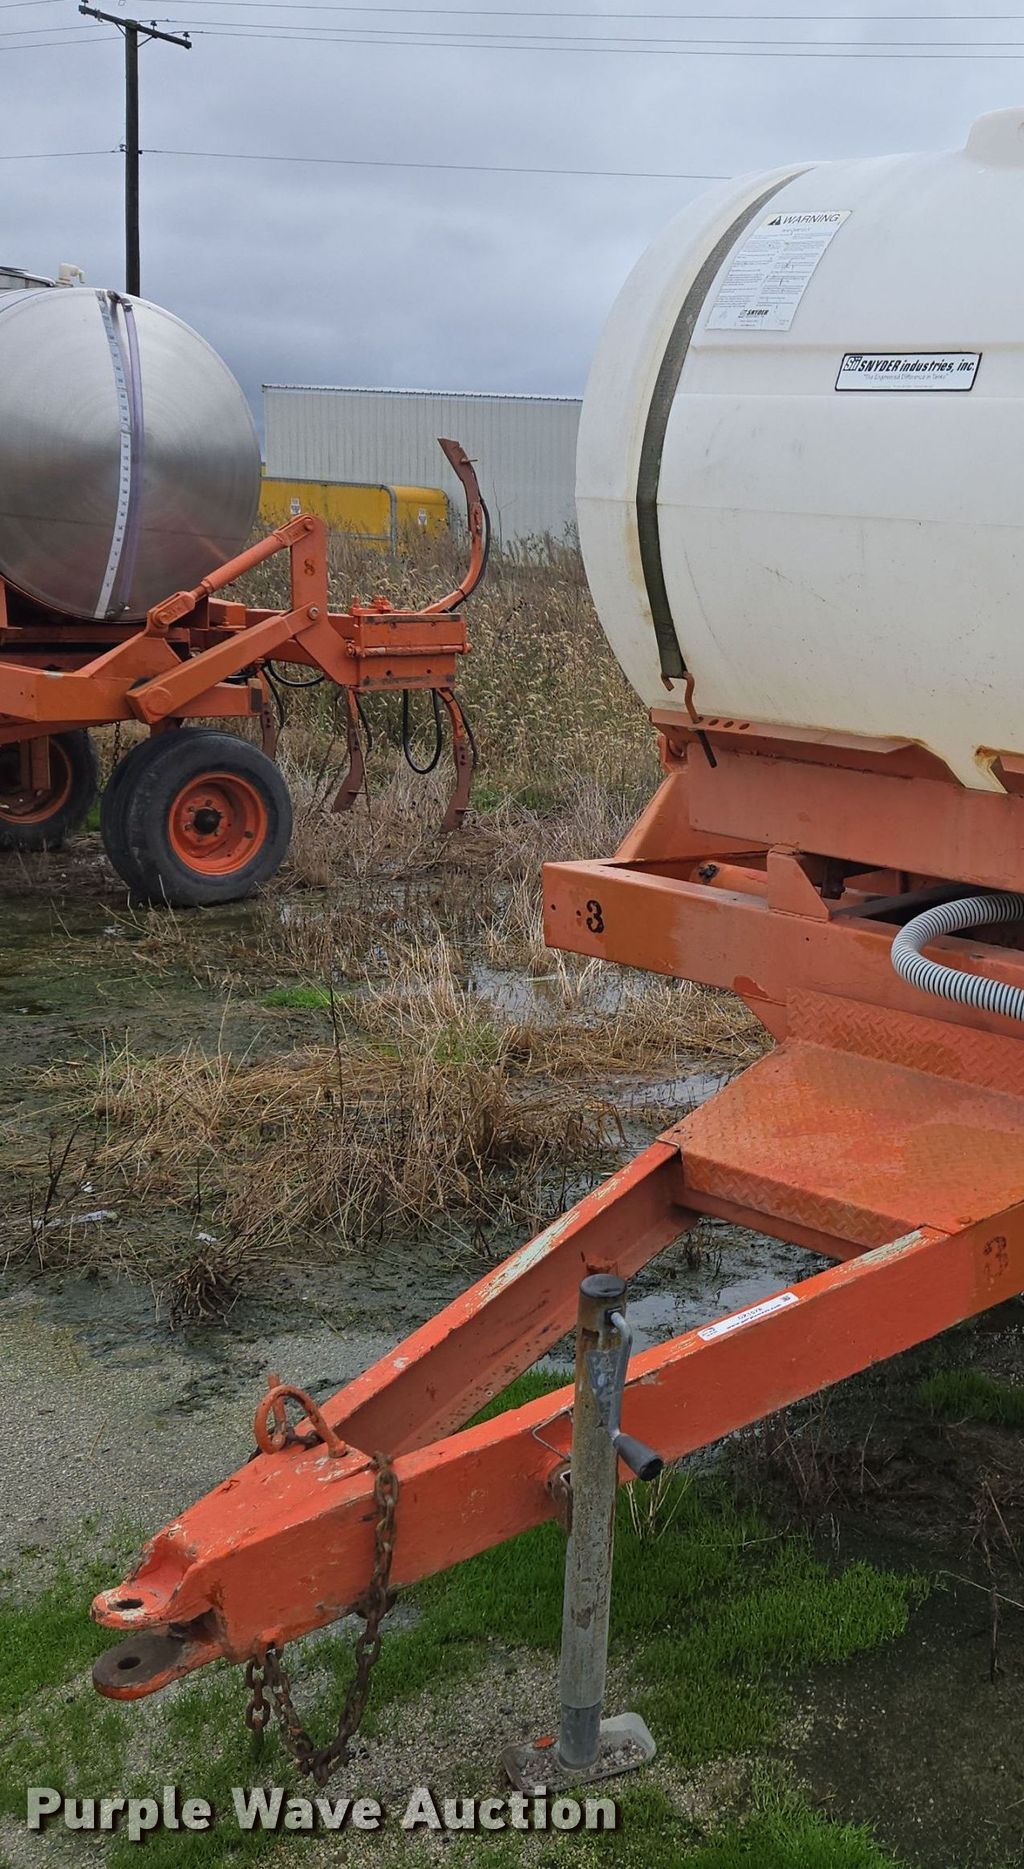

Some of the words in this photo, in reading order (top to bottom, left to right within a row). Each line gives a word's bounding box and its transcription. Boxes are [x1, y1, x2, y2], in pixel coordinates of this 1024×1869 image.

[783, 213, 841, 225] WARNING
[858, 360, 902, 372] SNYDER
[900, 359, 954, 373] industries,
[957, 359, 975, 371] inc.
[586, 900, 605, 933] 3
